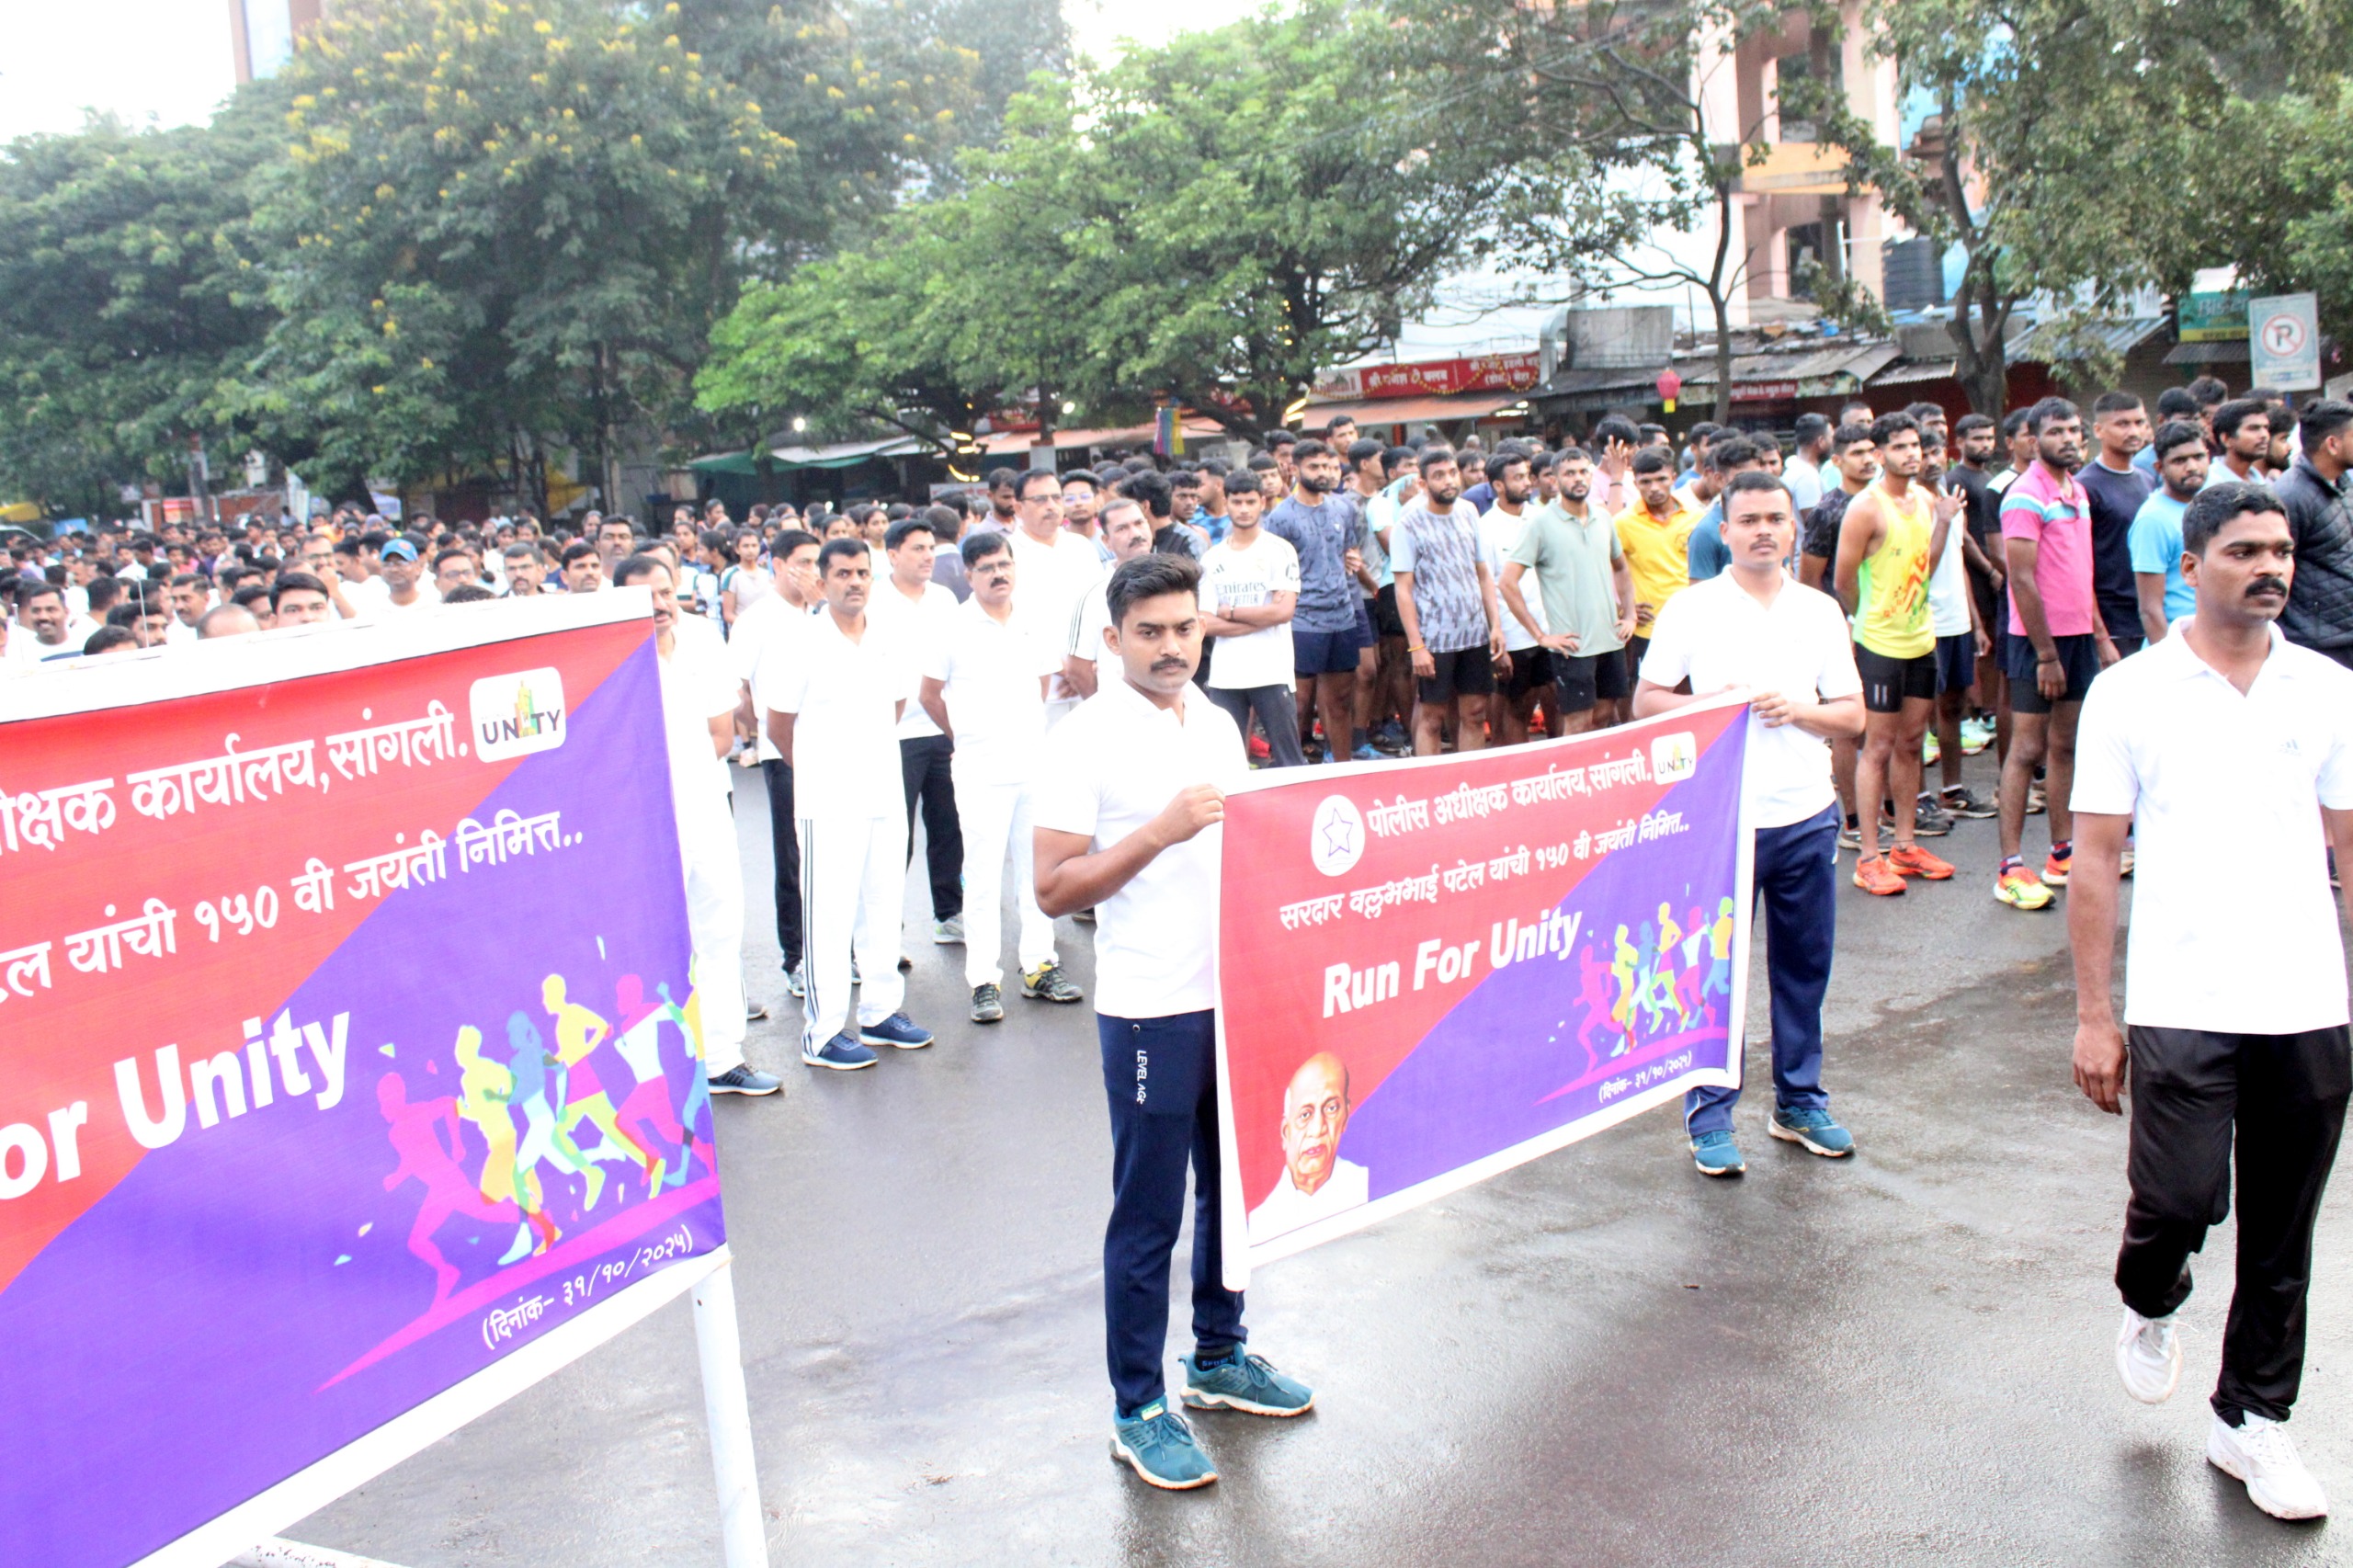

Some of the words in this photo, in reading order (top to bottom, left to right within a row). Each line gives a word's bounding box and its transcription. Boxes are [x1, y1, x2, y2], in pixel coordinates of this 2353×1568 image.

[1366, 793, 1430, 838] पोलीस
[1434, 781, 1508, 825] अधीक्षक
[64, 897, 177, 973] यांची
[193, 884, 279, 944] १५०
[290, 857, 335, 914] वी
[344, 829, 447, 898] जयंती
[1279, 892, 1346, 931] सरदार
[1348, 863, 1439, 920] वल्लभभाई
[1443, 859, 1486, 893] पटेल
[1489, 844, 1530, 881] यांची
[1535, 842, 1569, 872] १५०
[1573, 829, 1592, 860] वी
[1594, 818, 1637, 855] जयंती
[1322, 960, 1401, 1019] Run
[1413, 937, 1481, 992] For
[1489, 905, 1583, 970] Unity
[0, 1099, 87, 1200] or
[113, 1006, 350, 1149] Unity
[1136, 1050, 1148, 1082] LEVEL
